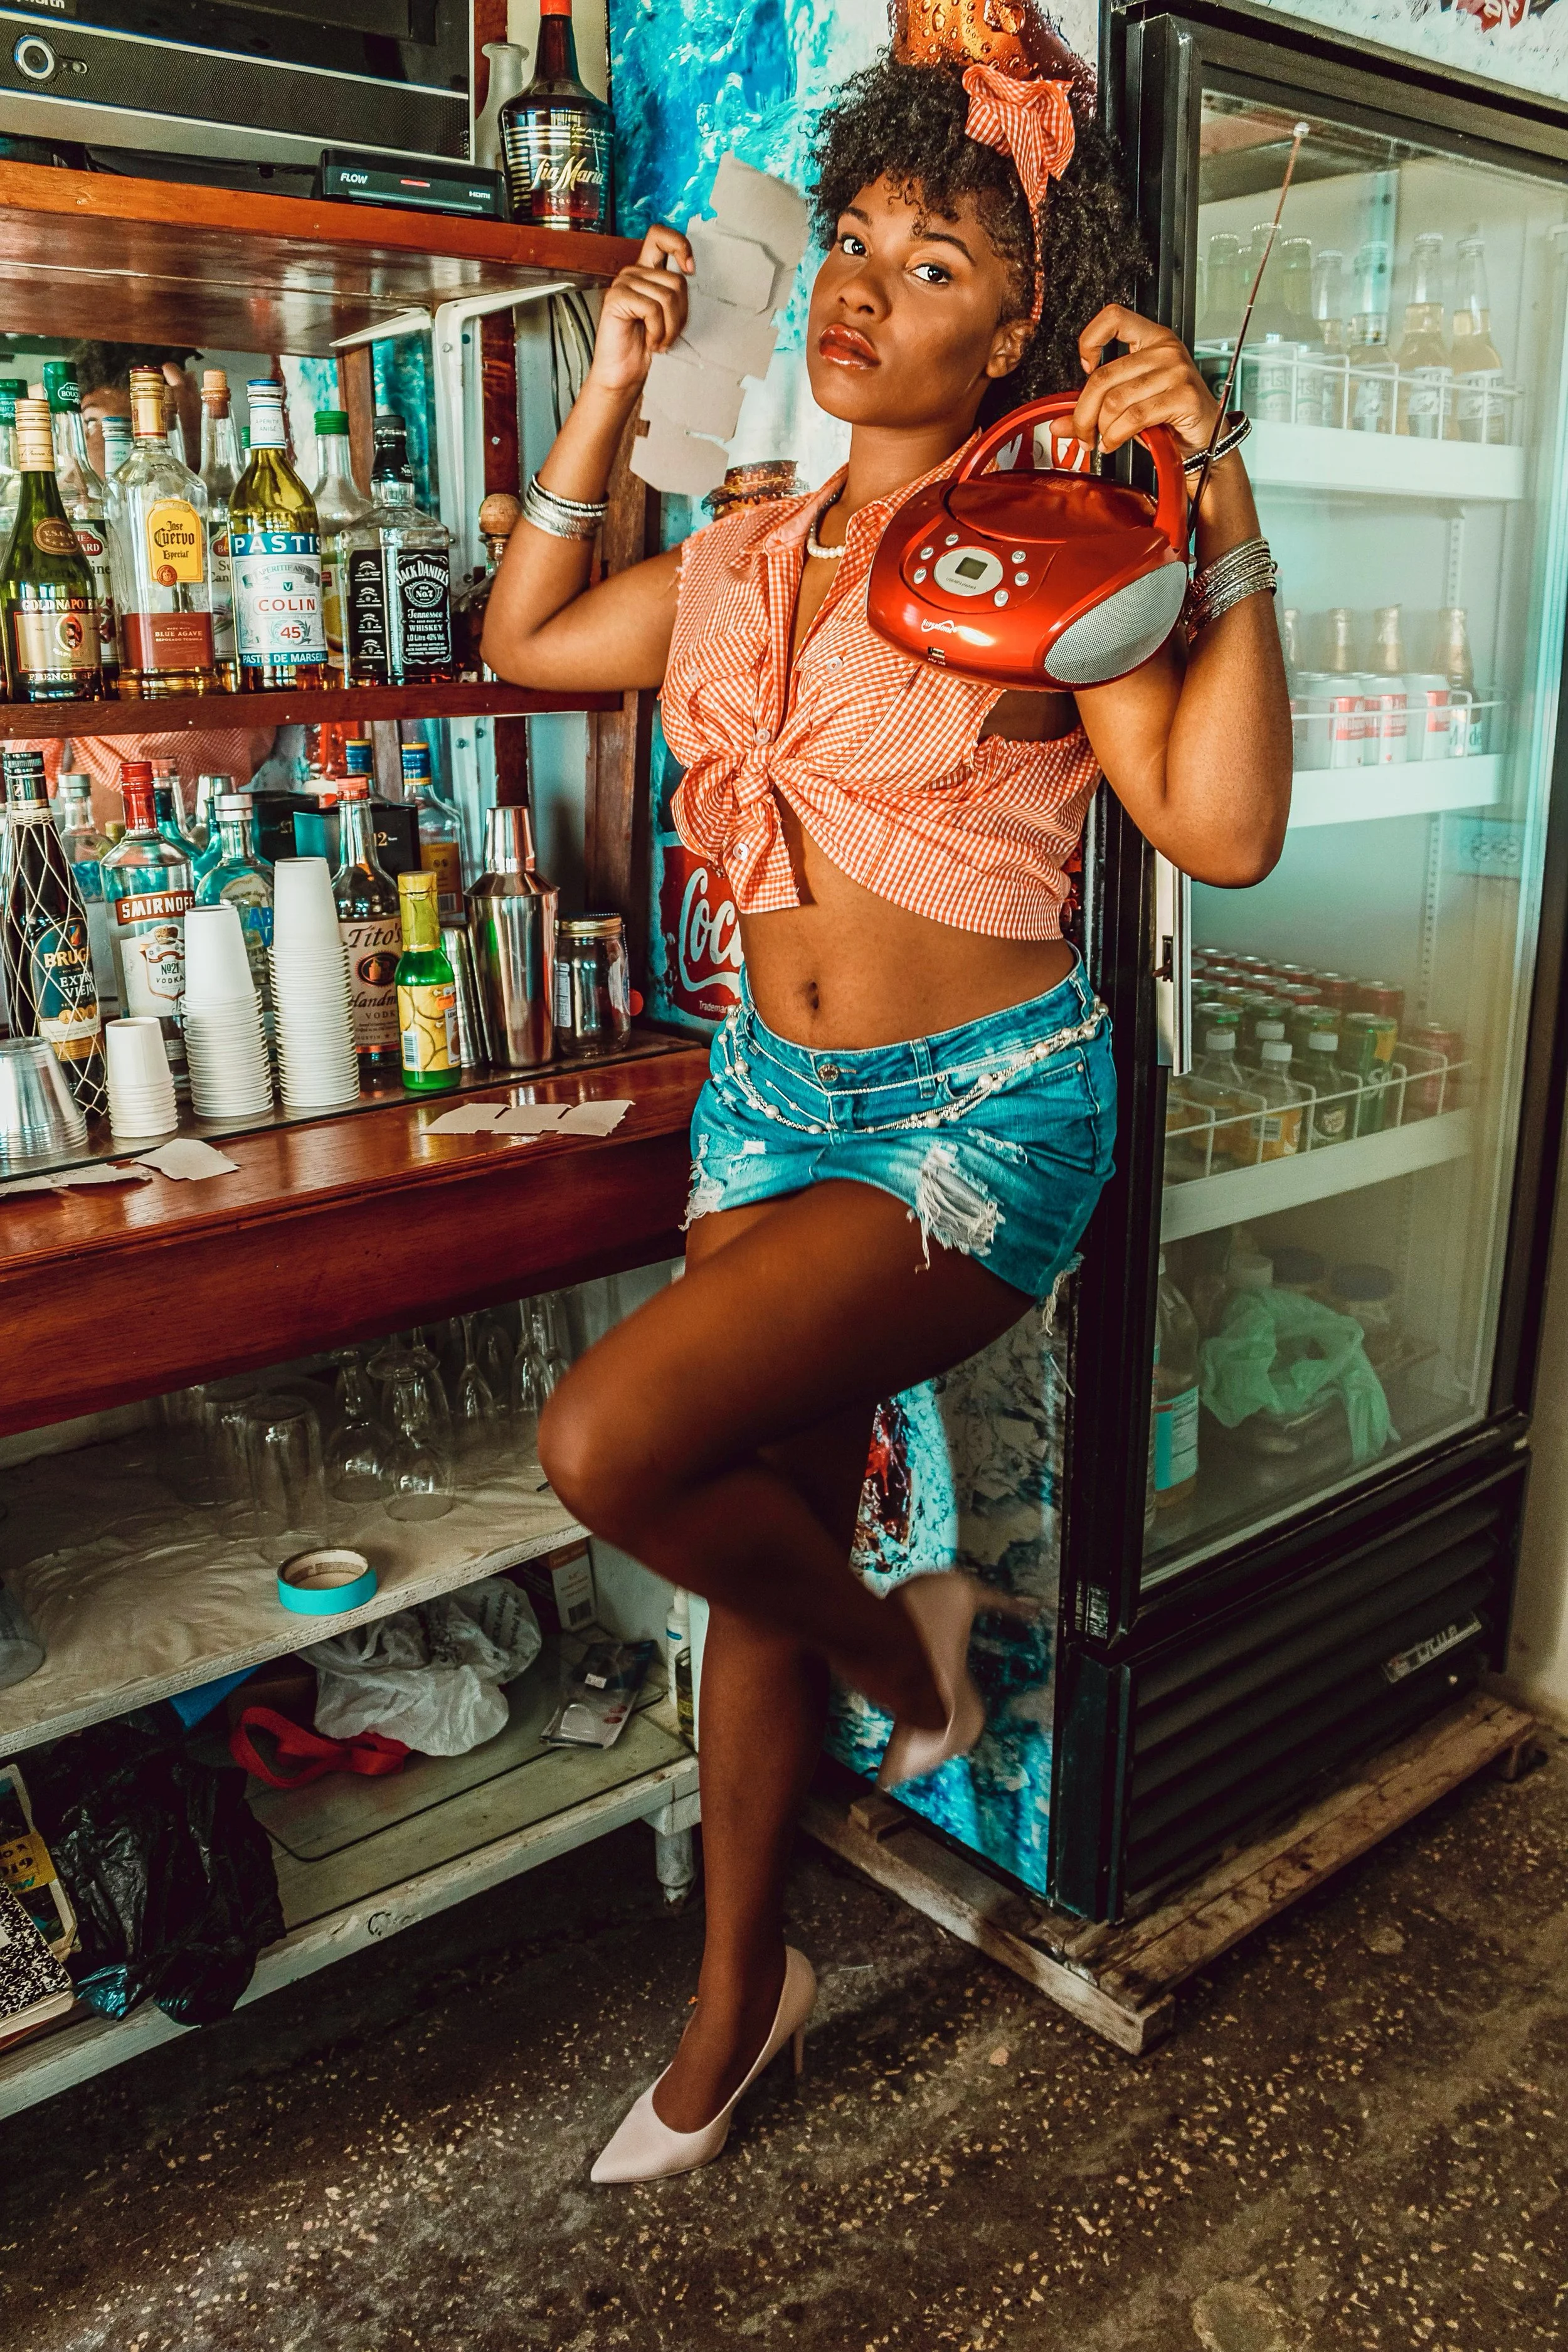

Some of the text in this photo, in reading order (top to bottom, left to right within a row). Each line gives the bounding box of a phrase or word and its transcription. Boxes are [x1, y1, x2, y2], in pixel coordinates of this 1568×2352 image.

[340, 172, 368, 184] FLOW
[526, 154, 605, 192] Tia Maria
[469, 191, 490, 199] HDMI
[166, 521, 183, 532] Jose
[154, 527, 195, 548] Cuervo
[162, 549, 189, 560] Especial
[395, 564, 418, 586] JACK
[416, 560, 450, 588] DANIEL'S
[22, 598, 55, 612] GOLD
[258, 599, 315, 612] COLIN
[407, 608, 443, 619] Tennessee
[280, 627, 301, 639] 45
[408, 624, 443, 632] WHISKEY
[243, 654, 270, 664] PASTIS
[273, 654, 289, 663] DE
[28, 672, 77, 681] FRENCH
[121, 896, 194, 919] SMIRNOFF
[348, 923, 402, 949] Tito's
[43, 947, 88, 969] BRUG
[699, 1000, 728, 1014] Trademar
[365, 1010, 396, 1019] VODK
